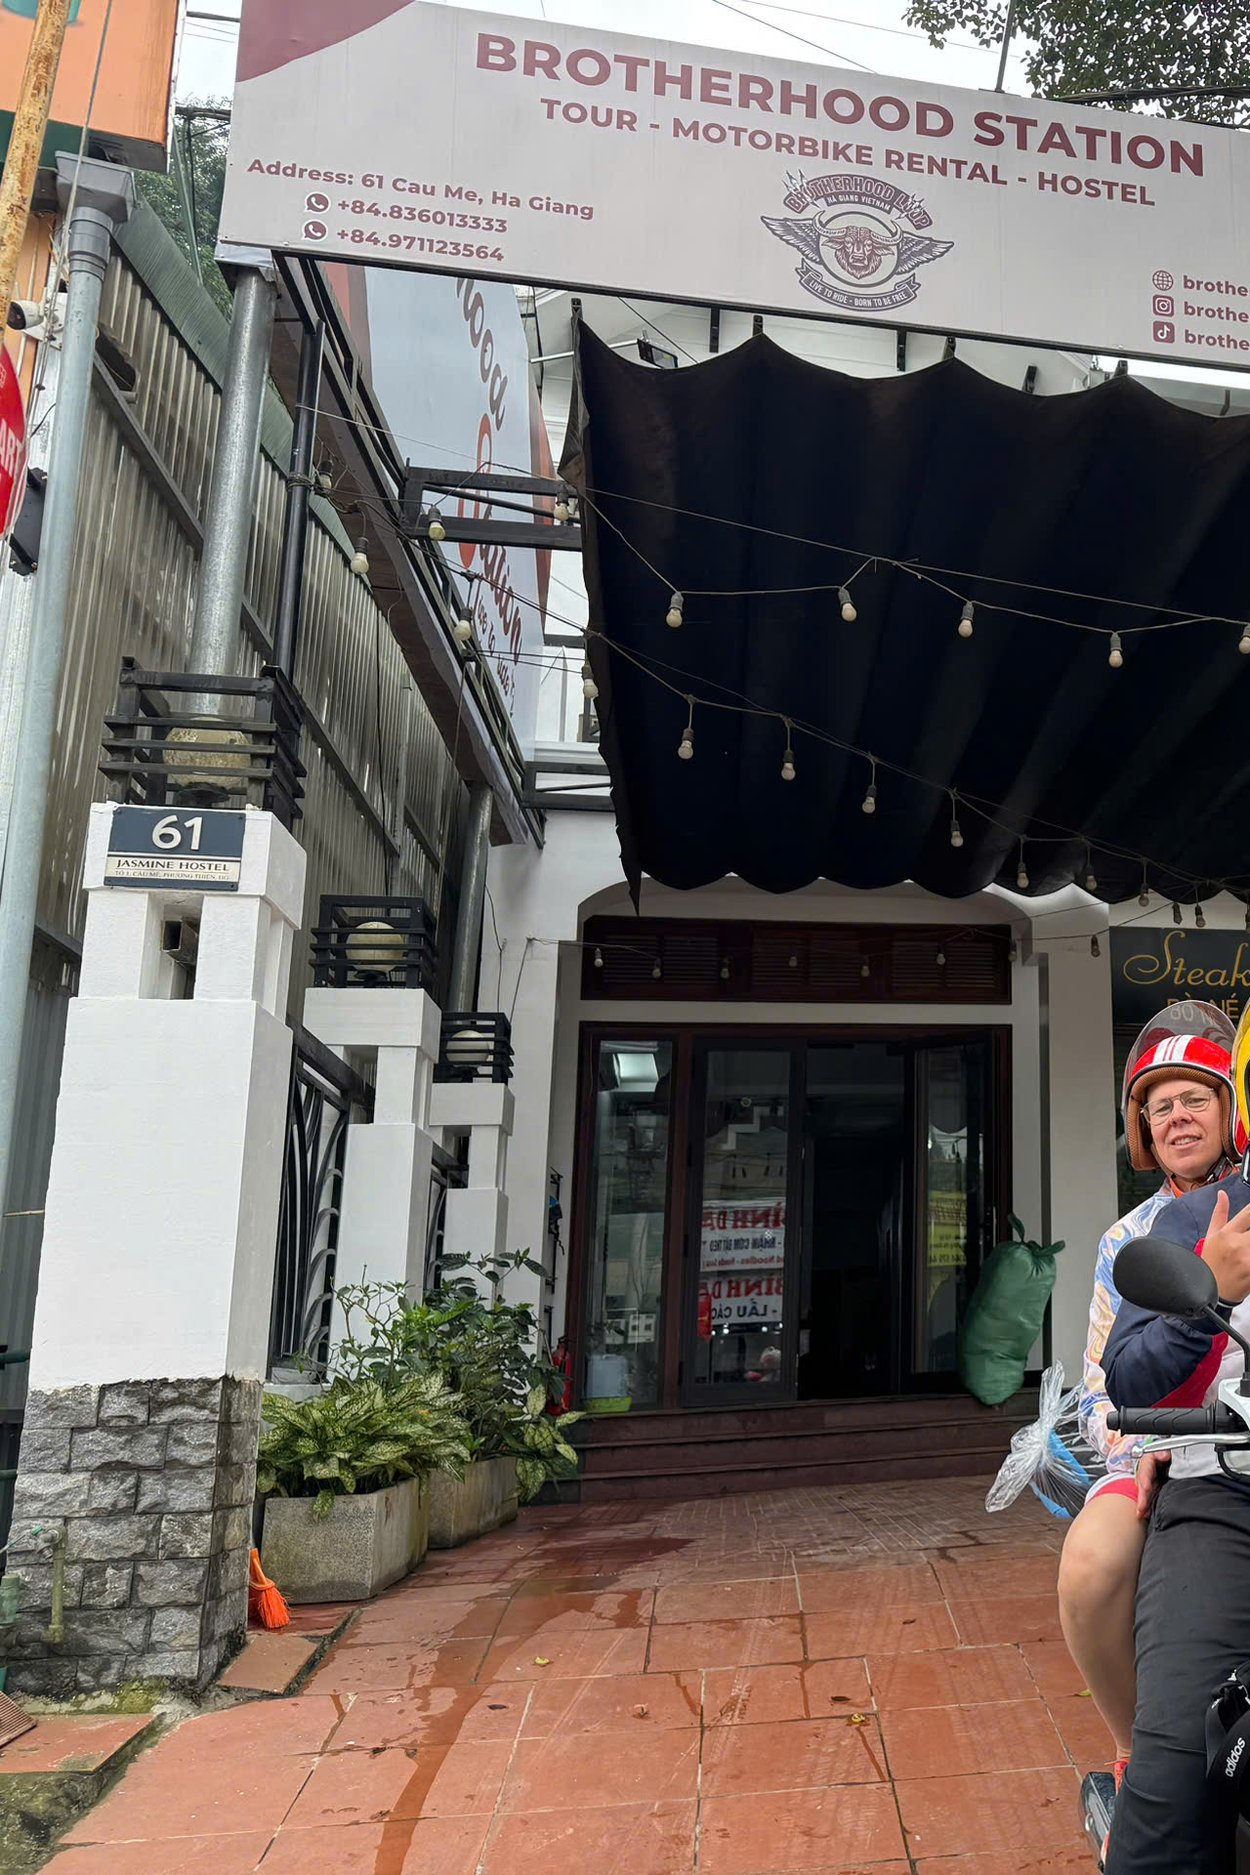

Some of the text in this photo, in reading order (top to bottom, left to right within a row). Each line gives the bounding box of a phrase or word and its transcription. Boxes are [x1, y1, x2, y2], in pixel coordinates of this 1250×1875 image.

[475, 32, 1204, 177] BROTHERHOOD STATION
[540, 98, 638, 132] TOUR
[673, 118, 873, 166] MOTORBIKE
[885, 149, 1008, 186] RENTAL
[1038, 172, 1156, 207] HOSTEL
[248, 158, 594, 220] Address: 61 Cau Me, Ha Giang
[337, 199, 508, 234] +84.836013333
[336, 228, 505, 261] +84.971123564
[809, 280, 822, 293] LIVE
[824, 288, 833, 297] TO
[832, 292, 848, 304] RIDE
[854, 298, 872, 307] BORN
[873, 298, 882, 306] TO
[883, 296, 892, 305] BE
[892, 292, 908, 303] FREE
[152, 814, 203, 851] 61
[116, 859, 230, 872] JASMINE HOSTEL
[1225, 1737, 1246, 1777] adidas
